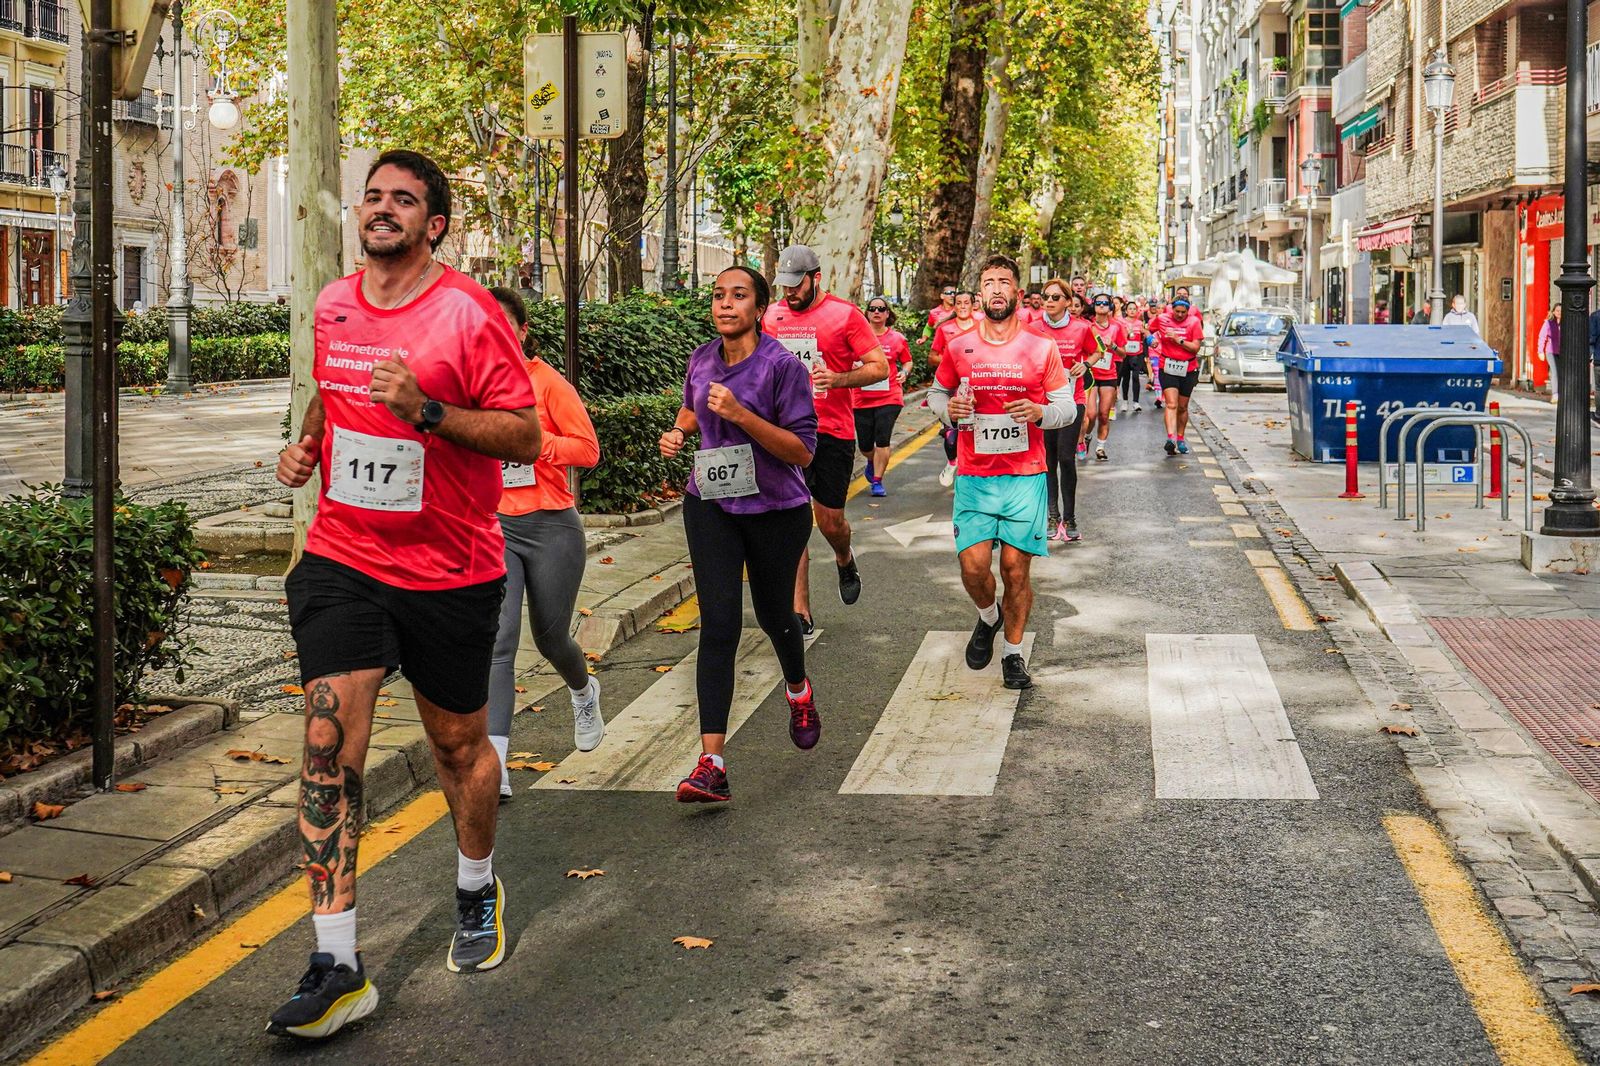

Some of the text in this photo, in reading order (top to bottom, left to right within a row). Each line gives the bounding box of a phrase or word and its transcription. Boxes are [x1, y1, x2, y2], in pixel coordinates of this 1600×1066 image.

[329, 340, 390, 357] kilómetros
[790, 350, 812, 361] 14
[325, 355, 380, 372] human
[1168, 363, 1184, 371] 1177
[971, 370, 1023, 379] humanidad
[971, 384, 1027, 393] CarreraCruzRoja
[982, 426, 1020, 440] 1705
[349, 458, 397, 484] 117
[707, 463, 739, 482] 667
[1454, 467, 1466, 482] P
